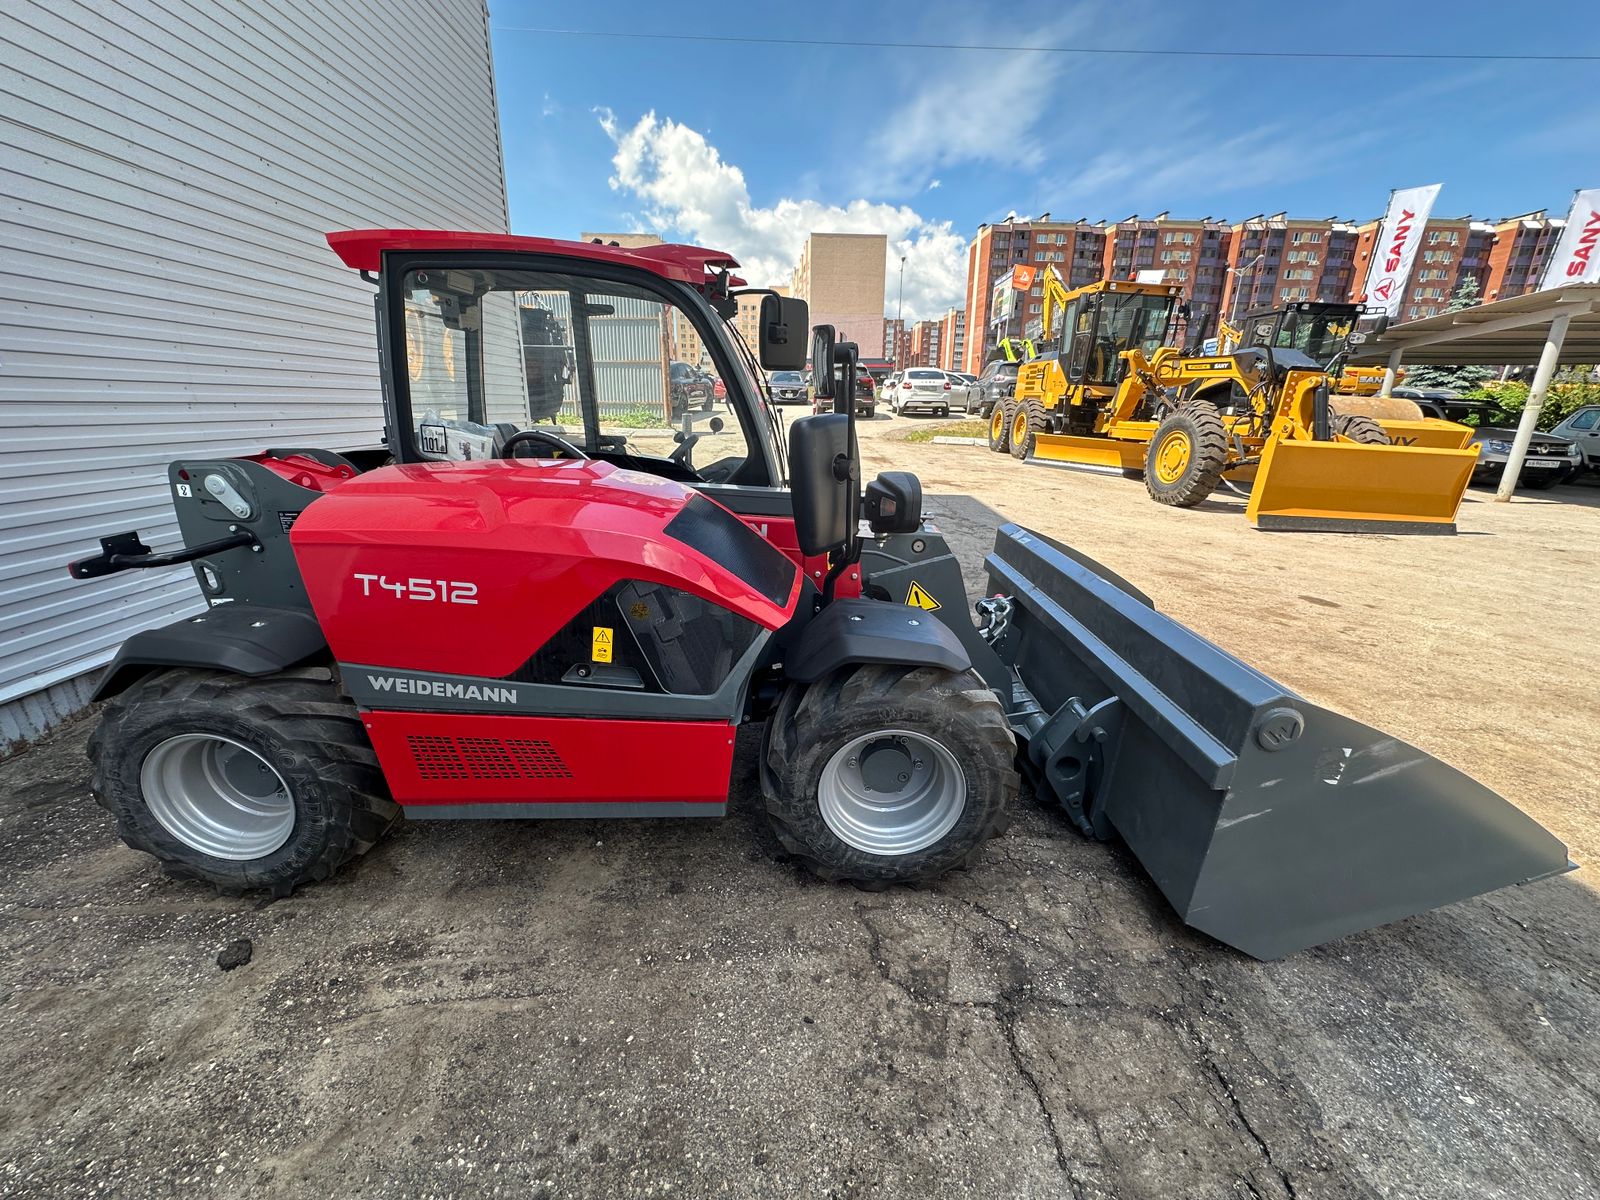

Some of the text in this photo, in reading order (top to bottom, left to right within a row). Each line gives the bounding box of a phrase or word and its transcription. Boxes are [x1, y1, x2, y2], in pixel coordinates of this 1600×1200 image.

[1385, 209, 1415, 273] SANY
[424, 437, 439, 451] 101
[354, 573, 478, 605] T4512
[367, 675, 517, 704] WEIDEMANN
